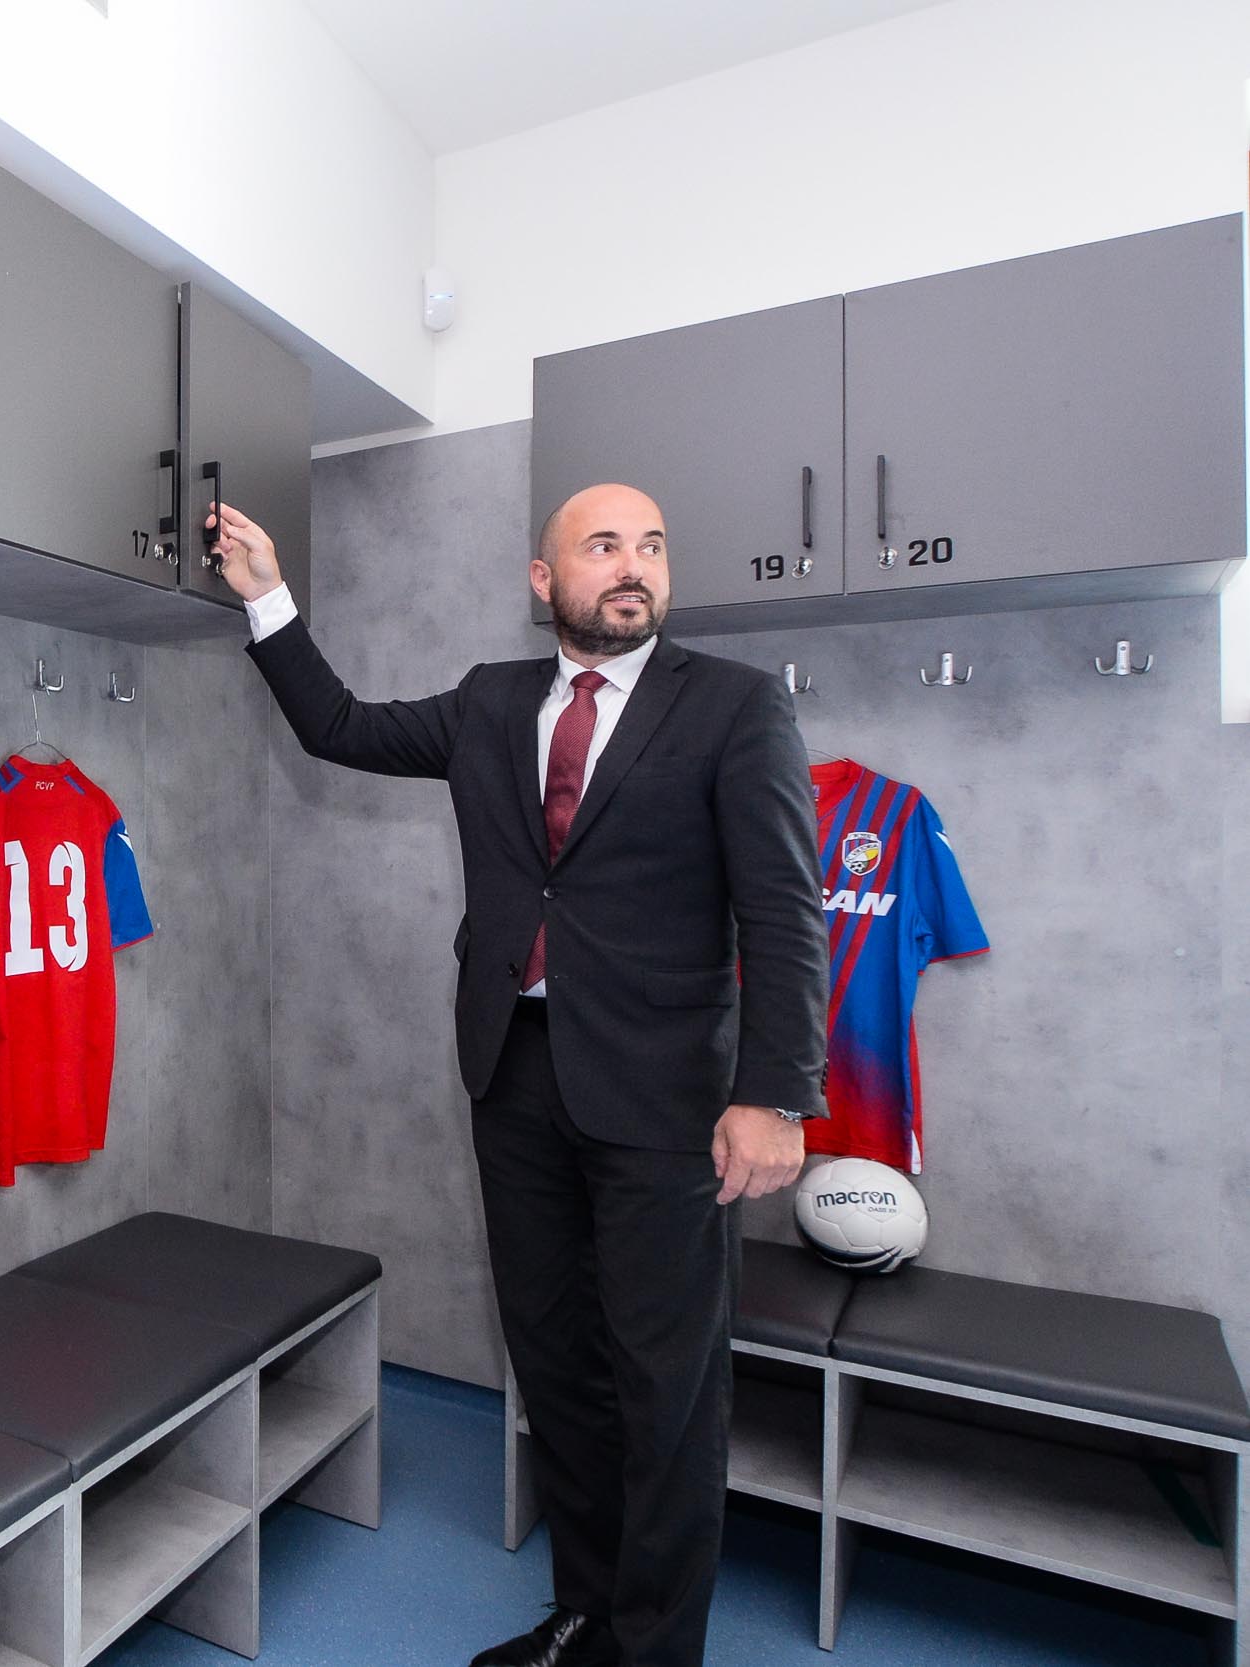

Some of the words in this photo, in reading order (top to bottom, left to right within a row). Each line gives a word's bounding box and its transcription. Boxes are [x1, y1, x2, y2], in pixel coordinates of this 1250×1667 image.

[132, 529, 149, 559] 17
[908, 537, 953, 566] 20
[750, 554, 784, 581] 19
[35, 781, 54, 790] FCVP
[4, 840, 88, 977] 13
[816, 1191, 896, 1208] macron
